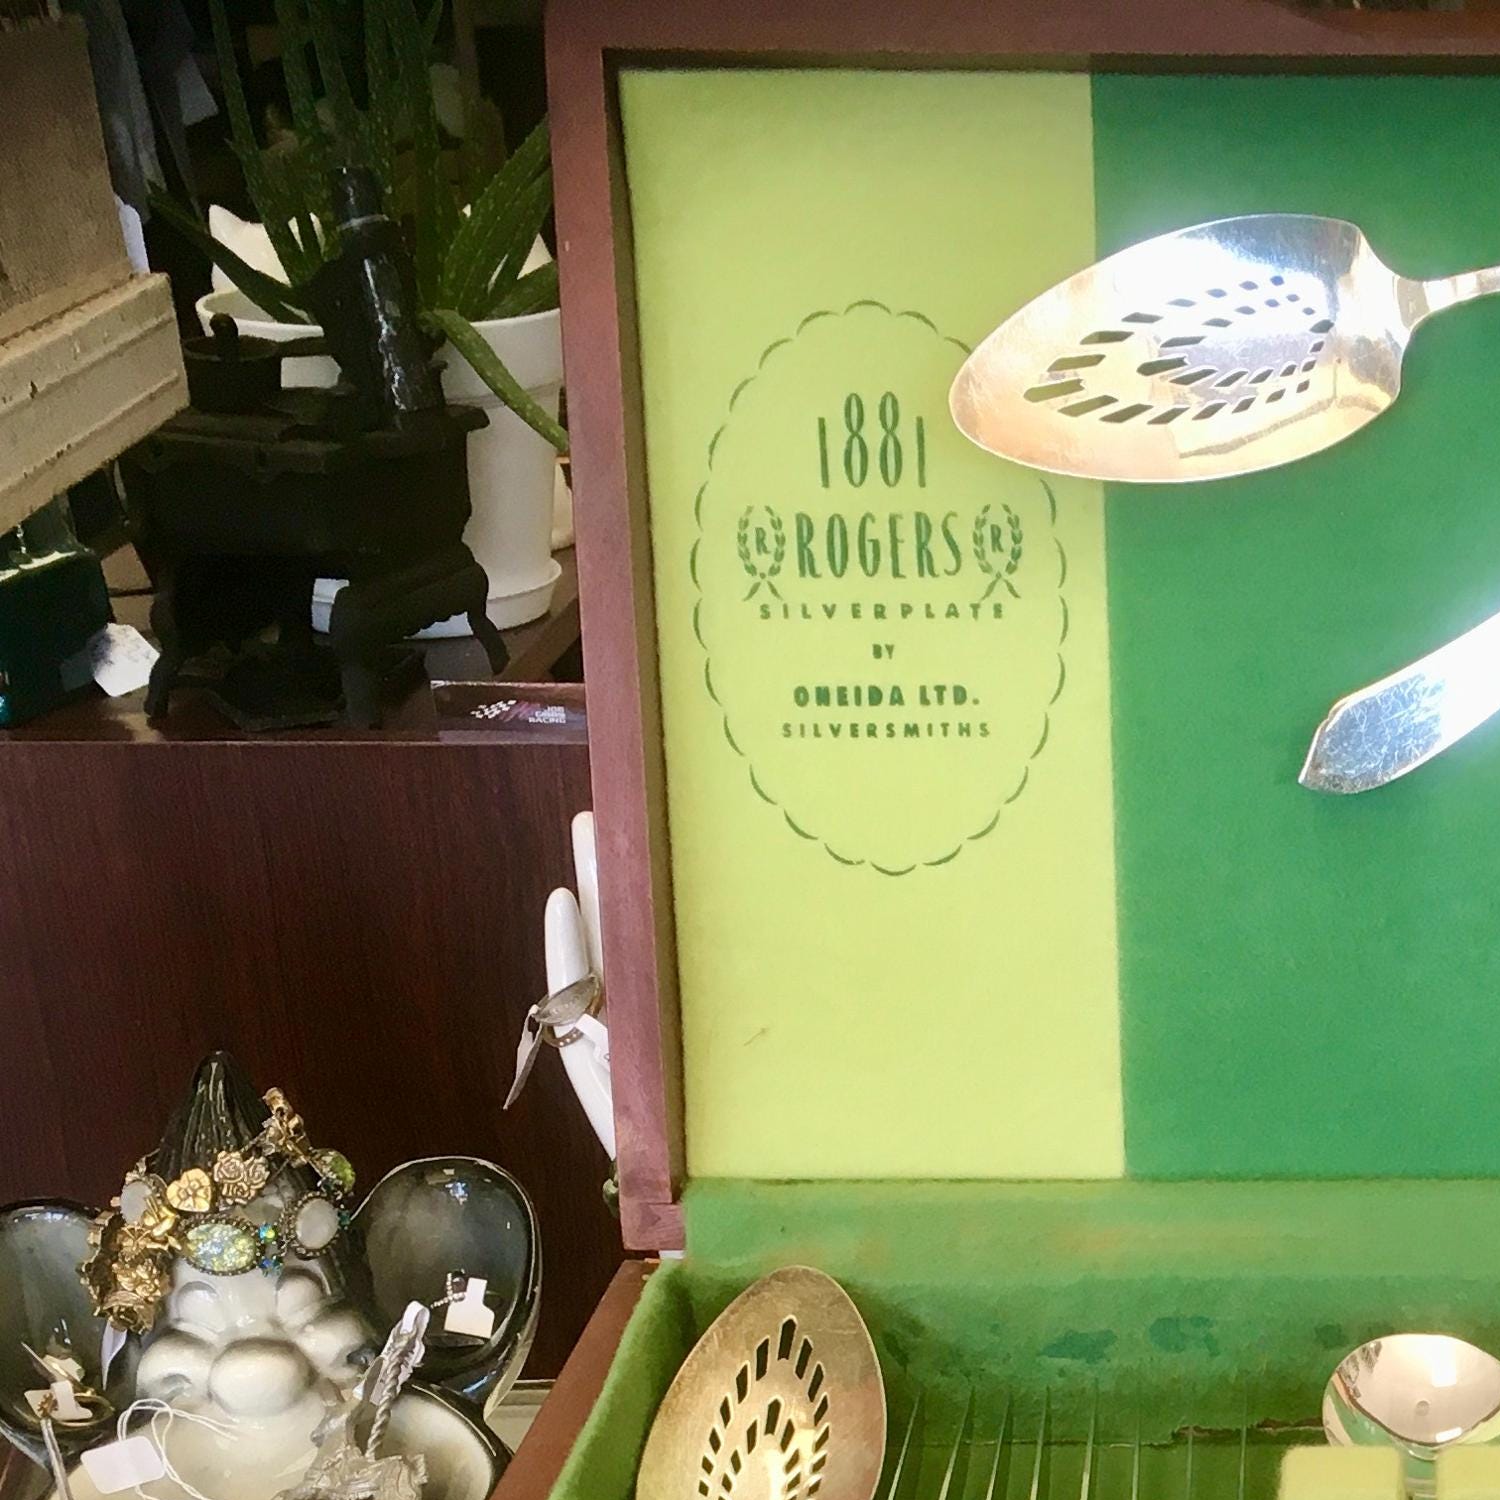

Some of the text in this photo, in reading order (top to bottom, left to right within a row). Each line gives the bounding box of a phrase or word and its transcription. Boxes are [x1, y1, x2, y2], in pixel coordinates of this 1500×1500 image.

[817, 390, 927, 489] 1881
[794, 510, 962, 579] ROGERS
[759, 602, 1004, 621] SILVERPLATE
[872, 643, 895, 660] BY
[793, 684, 981, 707] ONEIDA LTD.
[782, 722, 990, 738] SILVERSMITHS
